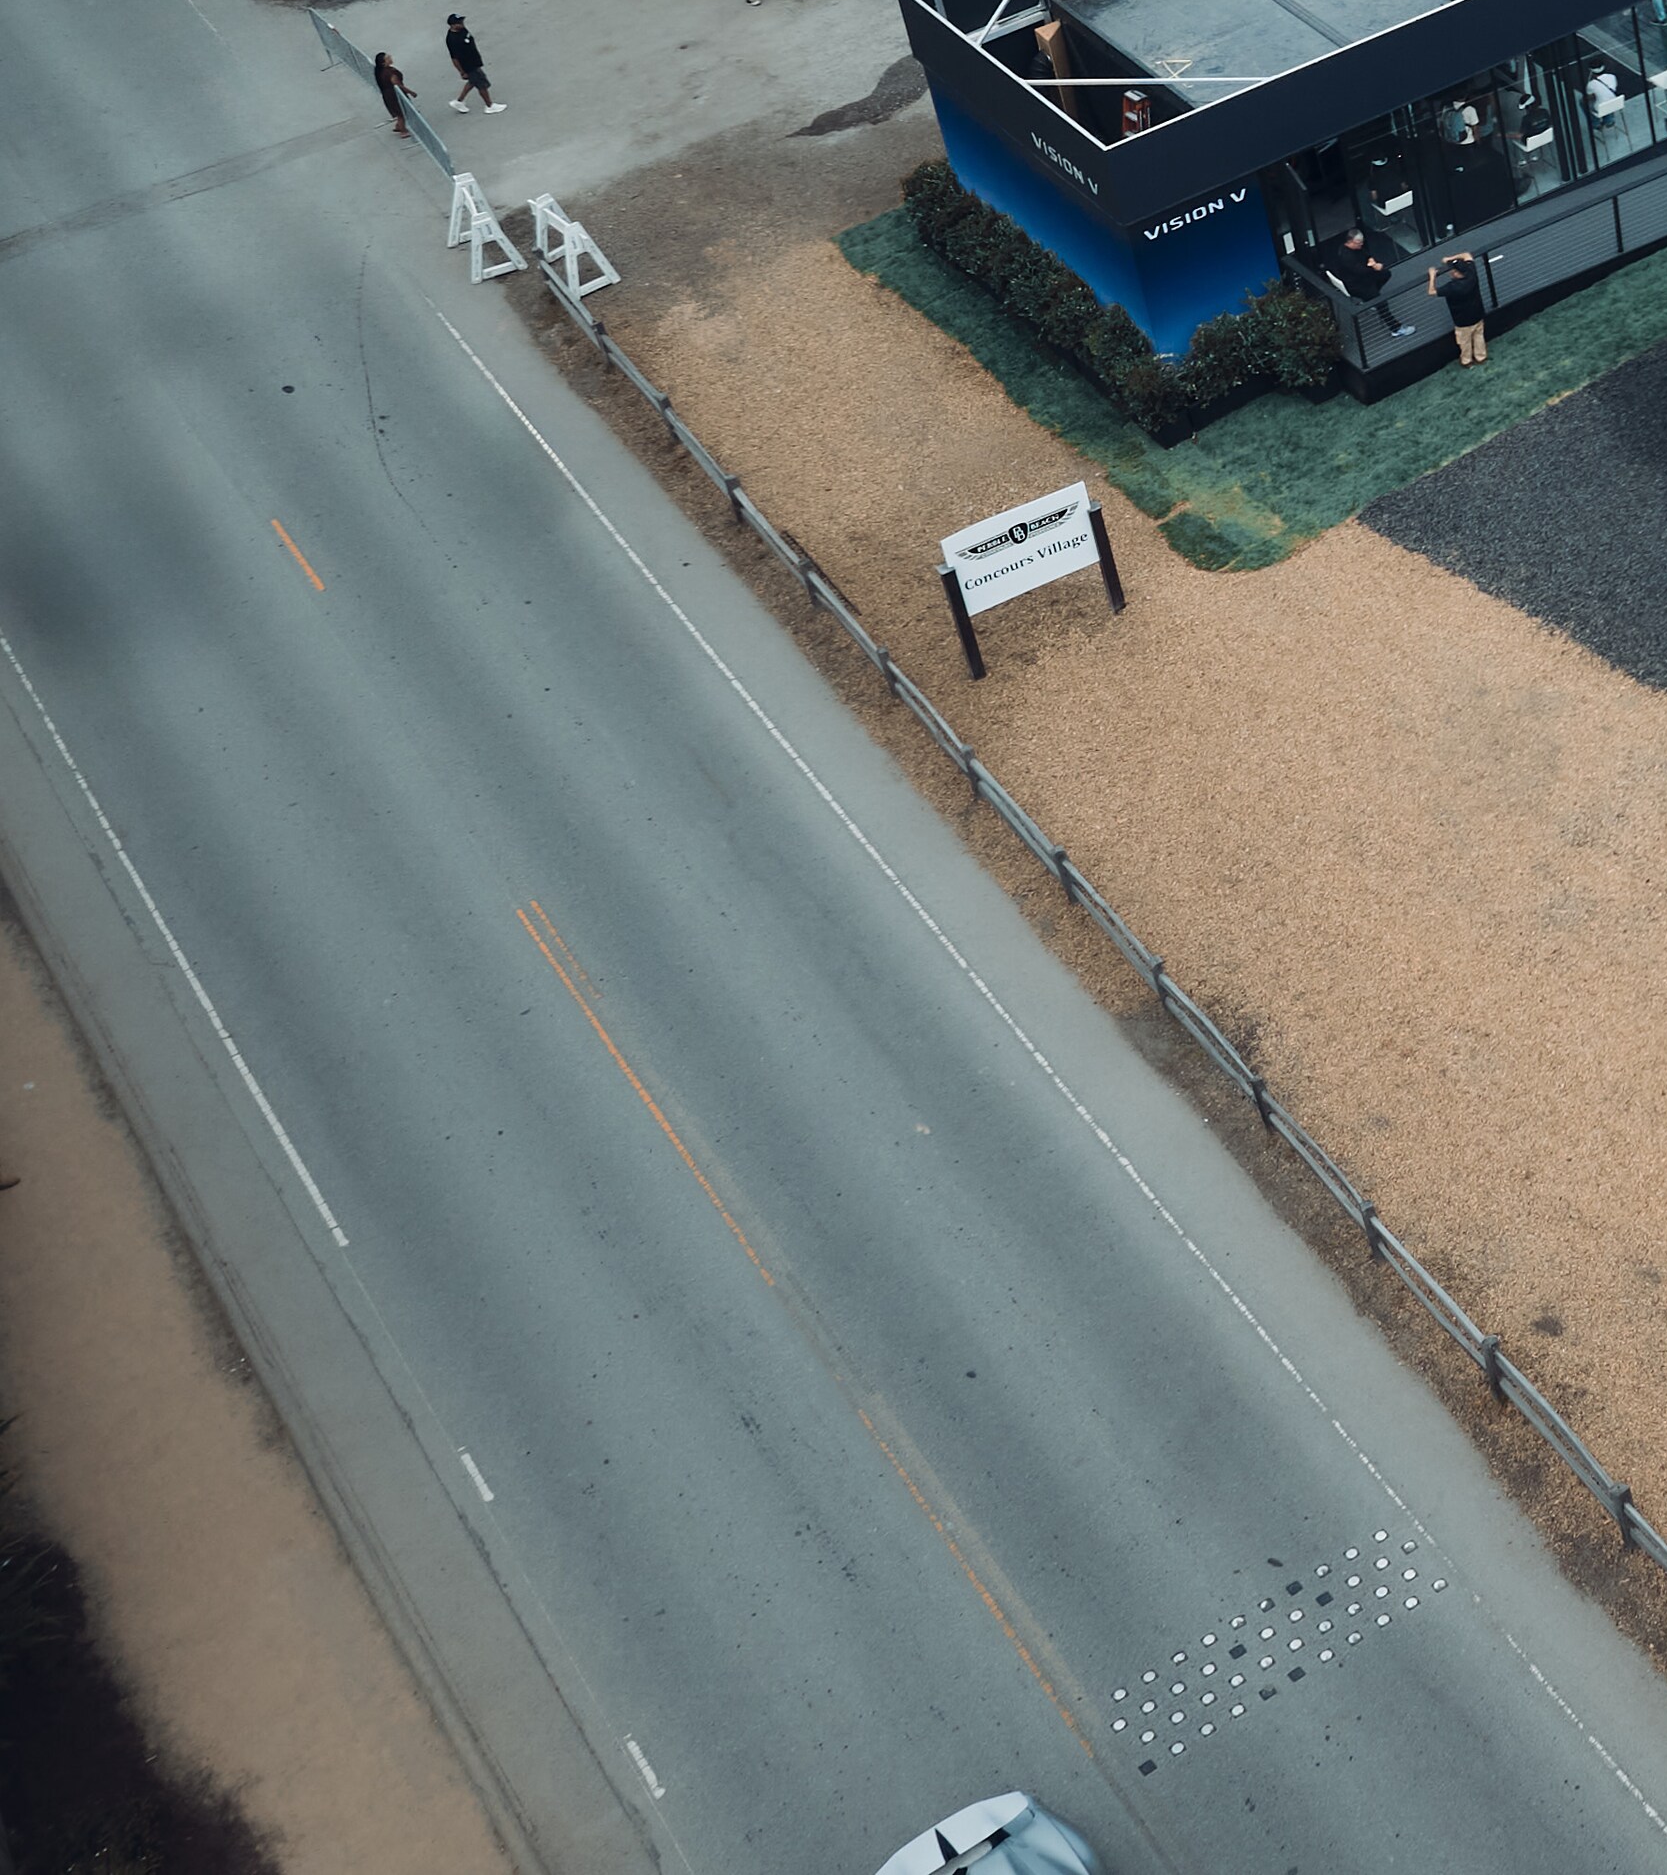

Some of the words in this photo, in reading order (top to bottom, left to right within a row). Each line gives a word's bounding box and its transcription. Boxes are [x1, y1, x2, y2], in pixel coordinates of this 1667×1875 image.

[1030, 131, 1085, 185] VISION
[1086, 182, 1099, 196] V
[1143, 198, 1225, 241] VISION
[1230, 188, 1248, 203] V
[964, 555, 1035, 591] Concours
[1037, 531, 1089, 560] Village
